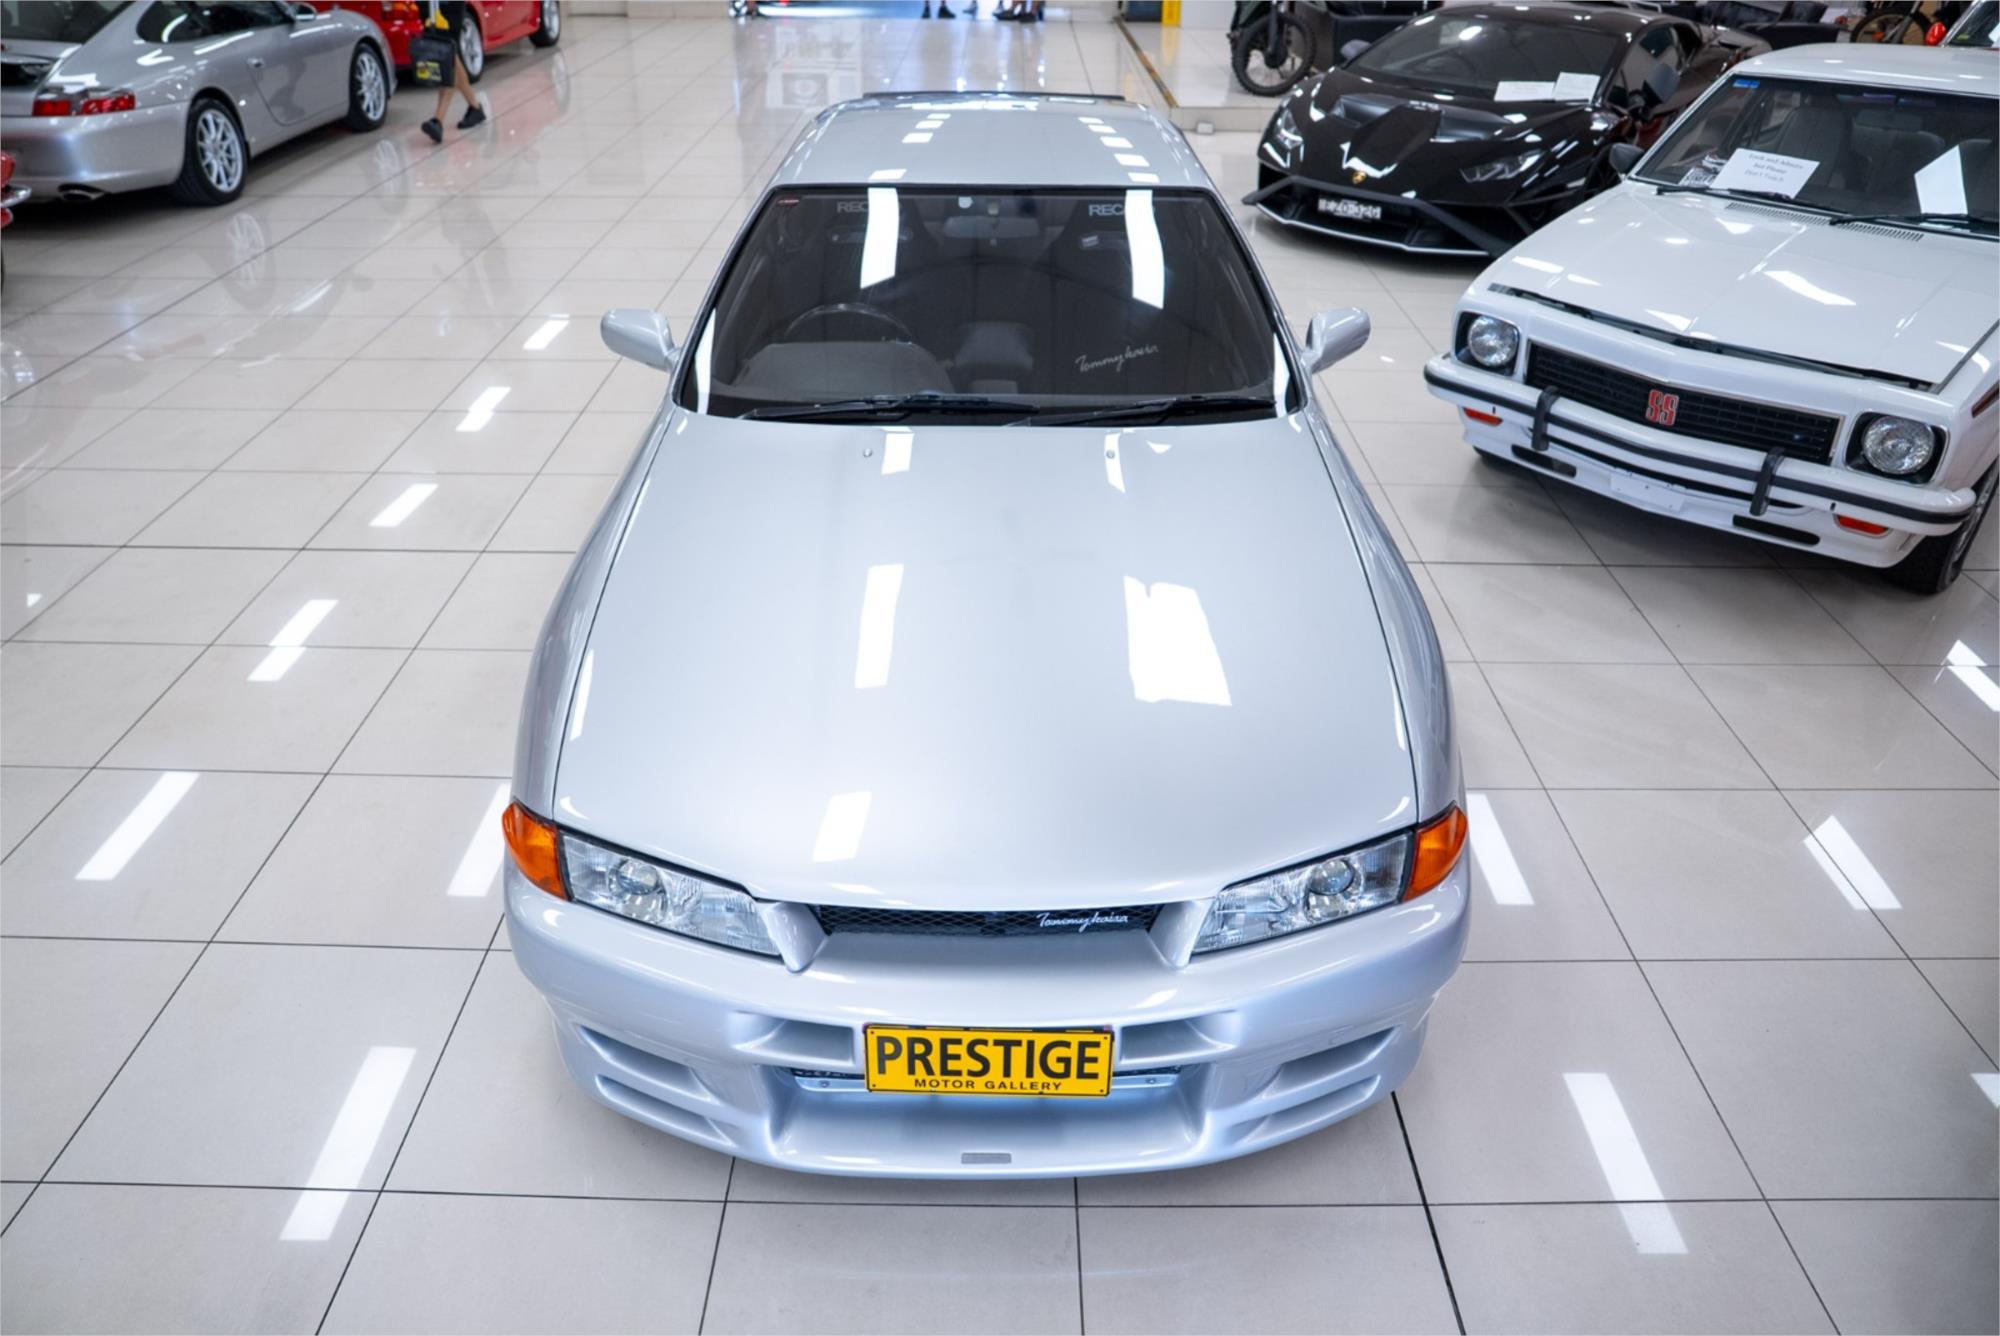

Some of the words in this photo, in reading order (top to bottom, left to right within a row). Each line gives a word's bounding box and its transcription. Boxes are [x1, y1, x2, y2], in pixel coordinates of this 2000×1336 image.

[837, 201, 869, 213] REC
[1089, 204, 1125, 216] REC
[876, 1035, 1101, 1080] PRESTIGE
[914, 1078, 975, 1089] MOTOR
[984, 1080, 1062, 1091] GALLERY
